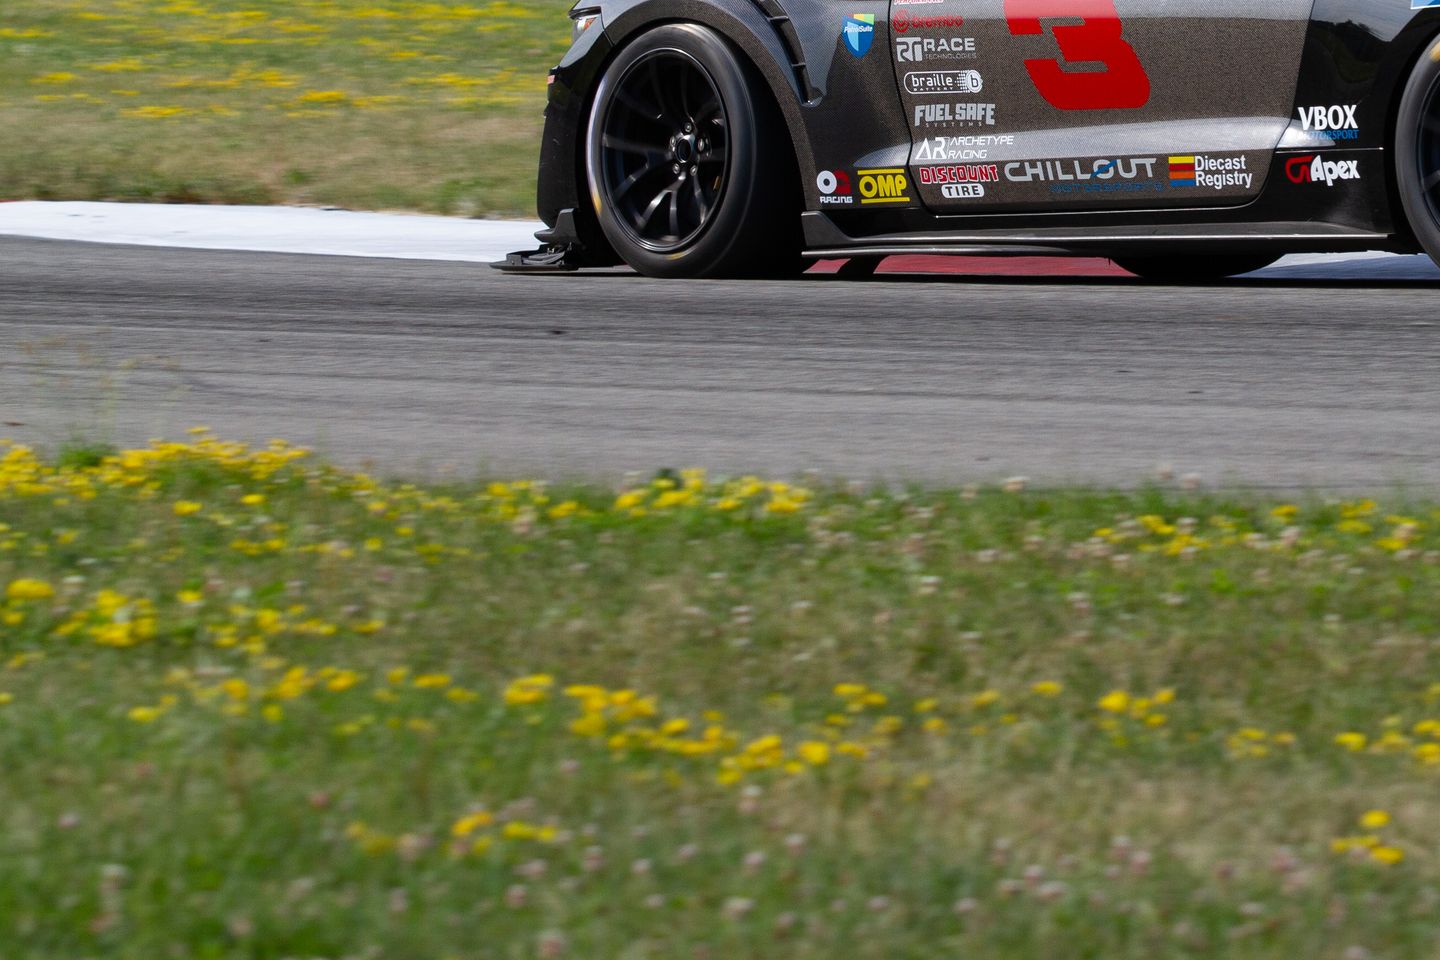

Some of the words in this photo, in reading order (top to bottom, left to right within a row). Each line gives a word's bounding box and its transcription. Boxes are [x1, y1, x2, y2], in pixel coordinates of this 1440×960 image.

[923, 37, 976, 52] RACE
[911, 73, 953, 87] braille
[914, 103, 953, 127] FUEL
[955, 103, 996, 125] SAFE
[1297, 104, 1359, 131] VBOX
[949, 135, 1015, 147] ARCHETYPE
[947, 149, 988, 159] RACING
[1193, 154, 1247, 172] Diecast
[919, 164, 999, 184] DISCOUNT
[1003, 157, 1158, 182] CHILLOUT
[859, 174, 908, 198] OMP
[1194, 171, 1253, 190] Registry
[819, 195, 853, 204] RACING
[945, 185, 981, 196] TIRE
